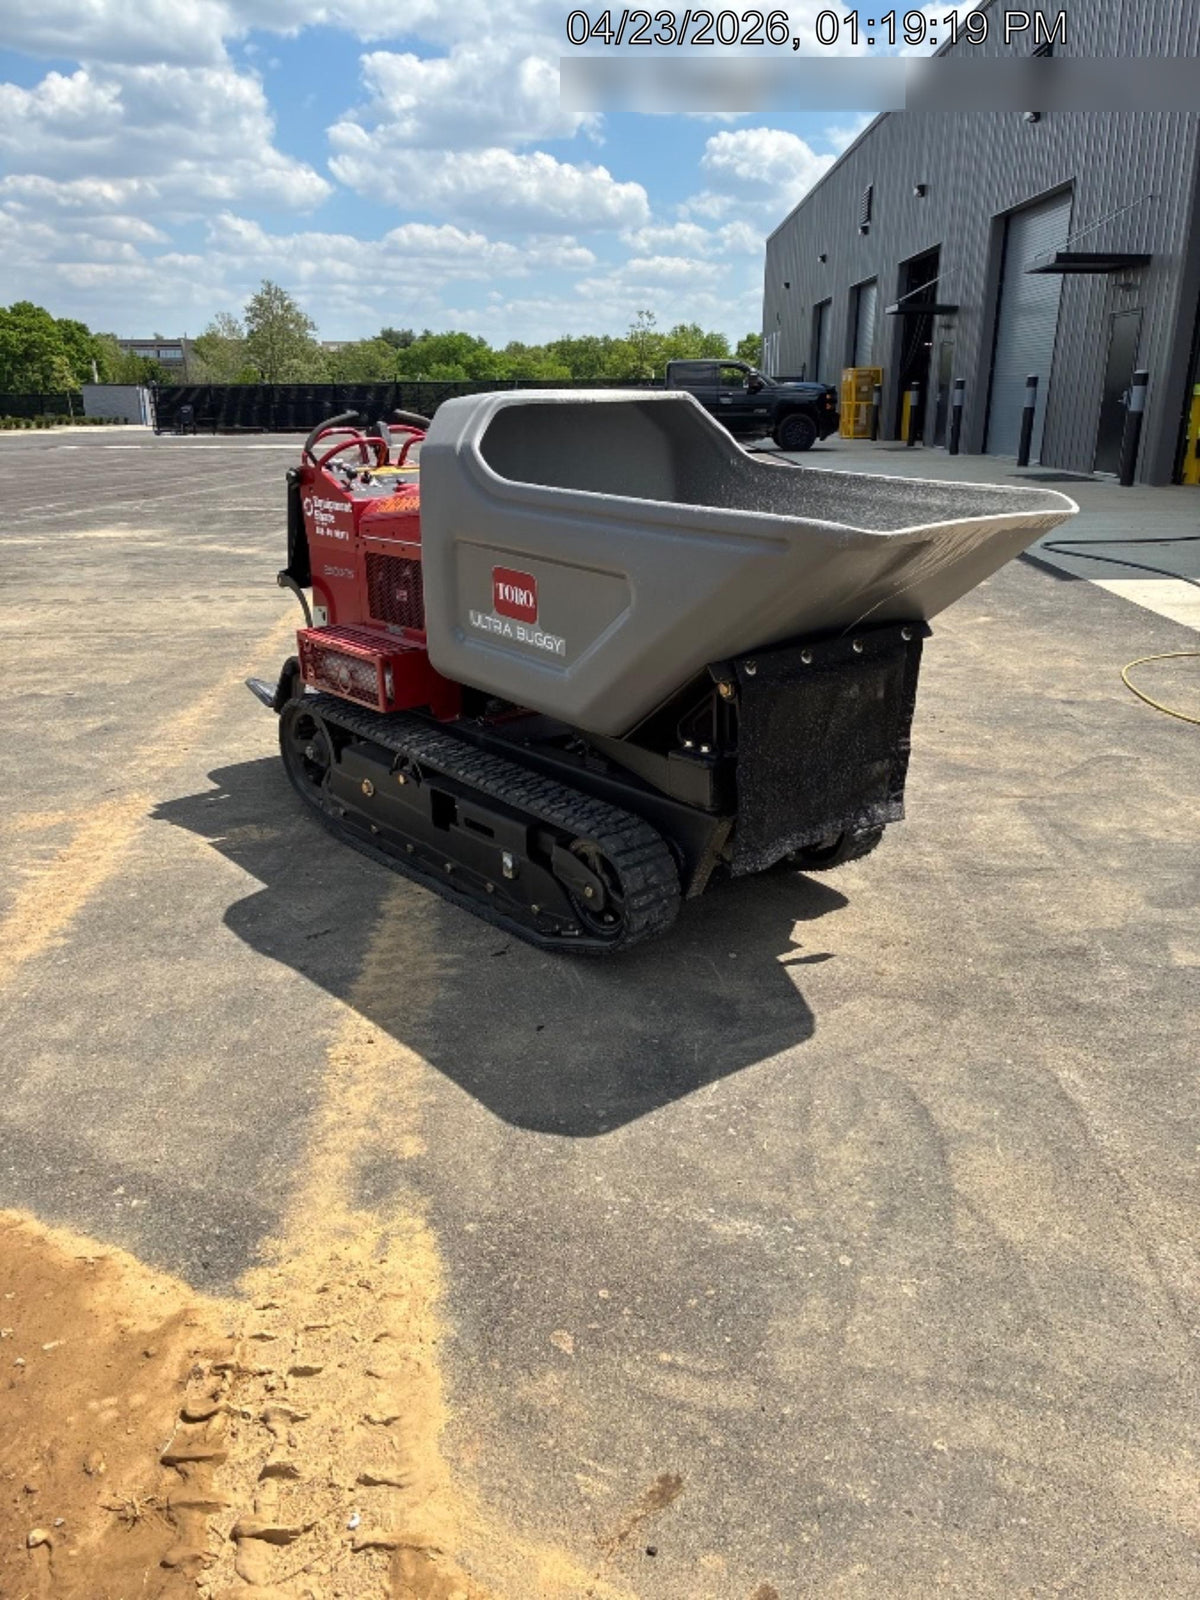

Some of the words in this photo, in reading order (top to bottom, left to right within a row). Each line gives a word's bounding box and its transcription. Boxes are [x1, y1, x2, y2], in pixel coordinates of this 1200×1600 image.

[496, 582, 535, 608] TORO
[470, 610, 513, 637] ULTRA
[516, 626, 563, 654] BUGGY
